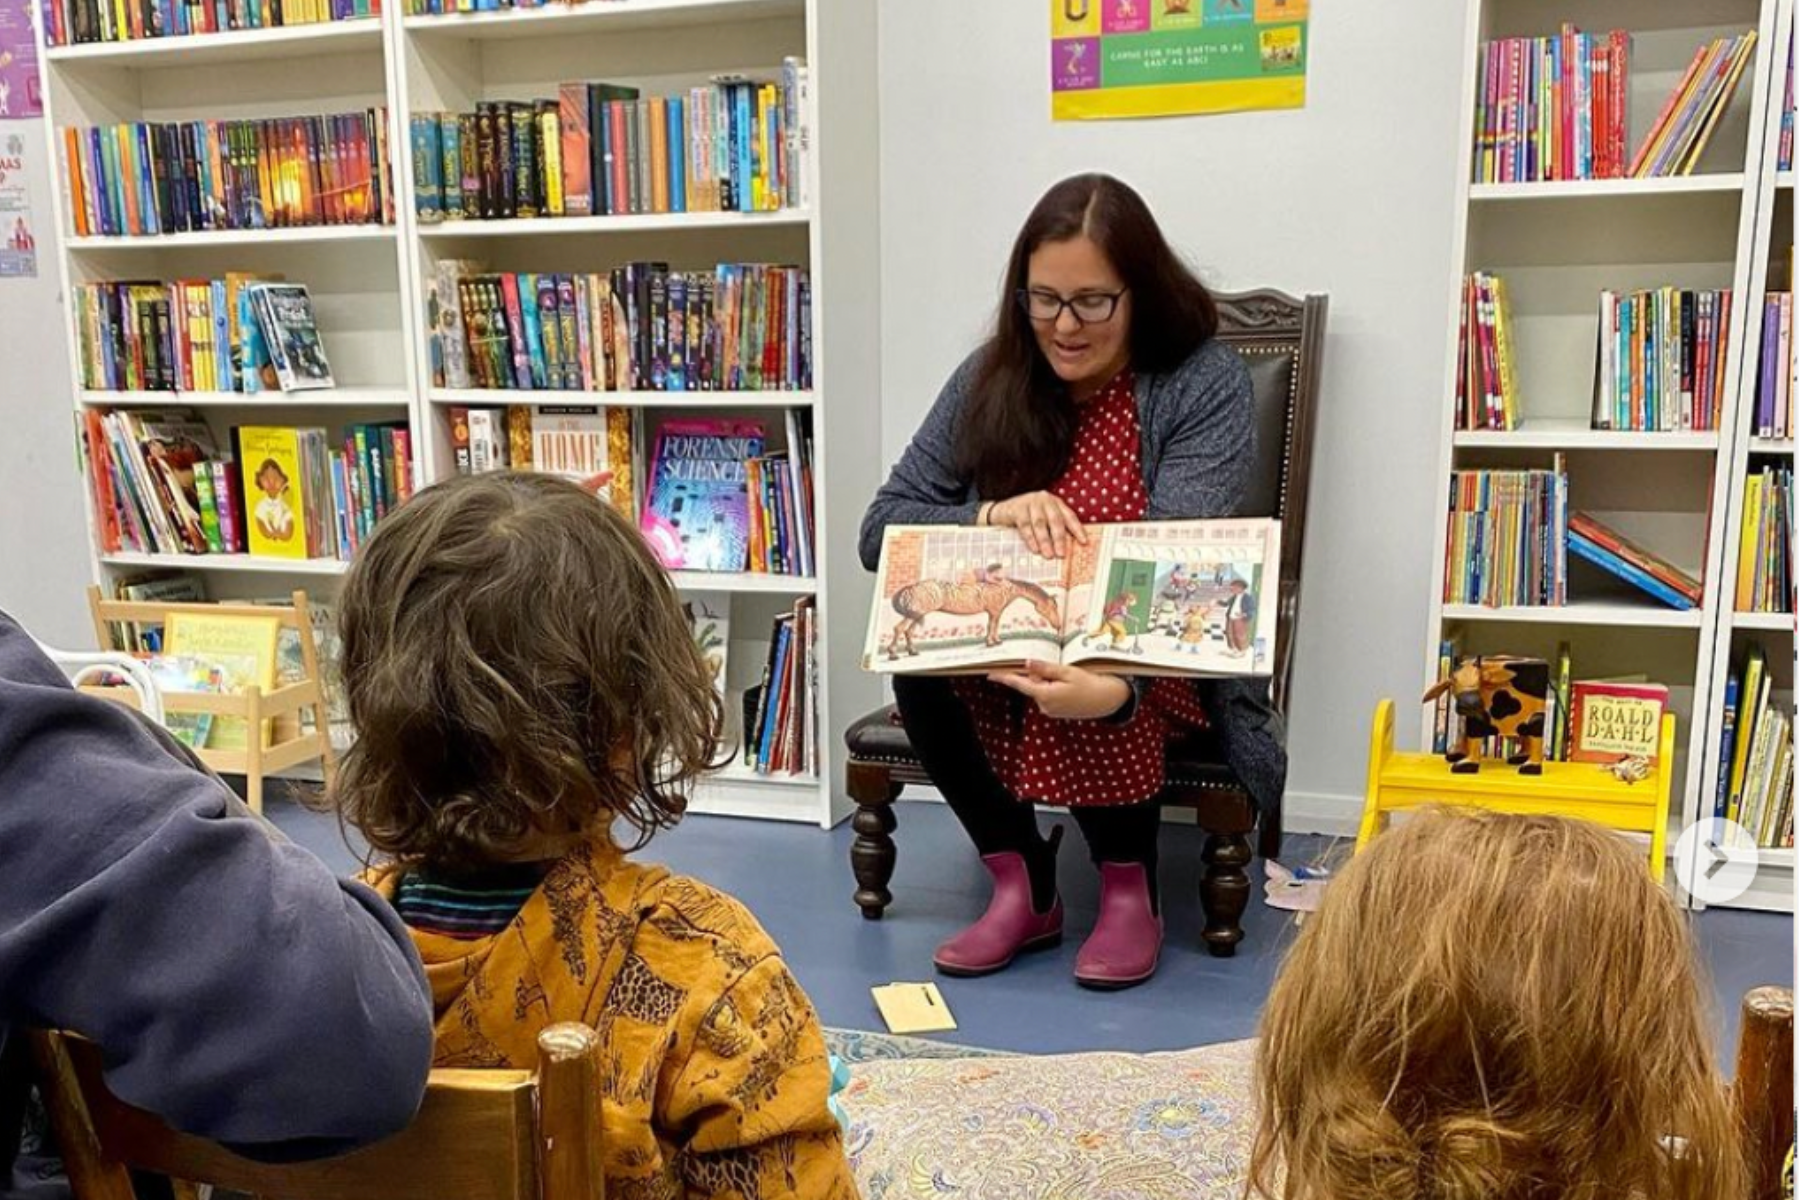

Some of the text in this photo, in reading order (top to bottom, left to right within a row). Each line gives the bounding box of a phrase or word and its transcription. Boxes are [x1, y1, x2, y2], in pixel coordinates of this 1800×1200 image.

[1110, 50, 1141, 61] CARING
[1144, 48, 1163, 58] FOR
[1166, 47, 1183, 56] THE
[1186, 45, 1218, 55] EARTH
[663, 435, 760, 458] FORENSIC
[664, 459, 747, 482] SCIENCE
[1589, 704, 1653, 726] ROALD
